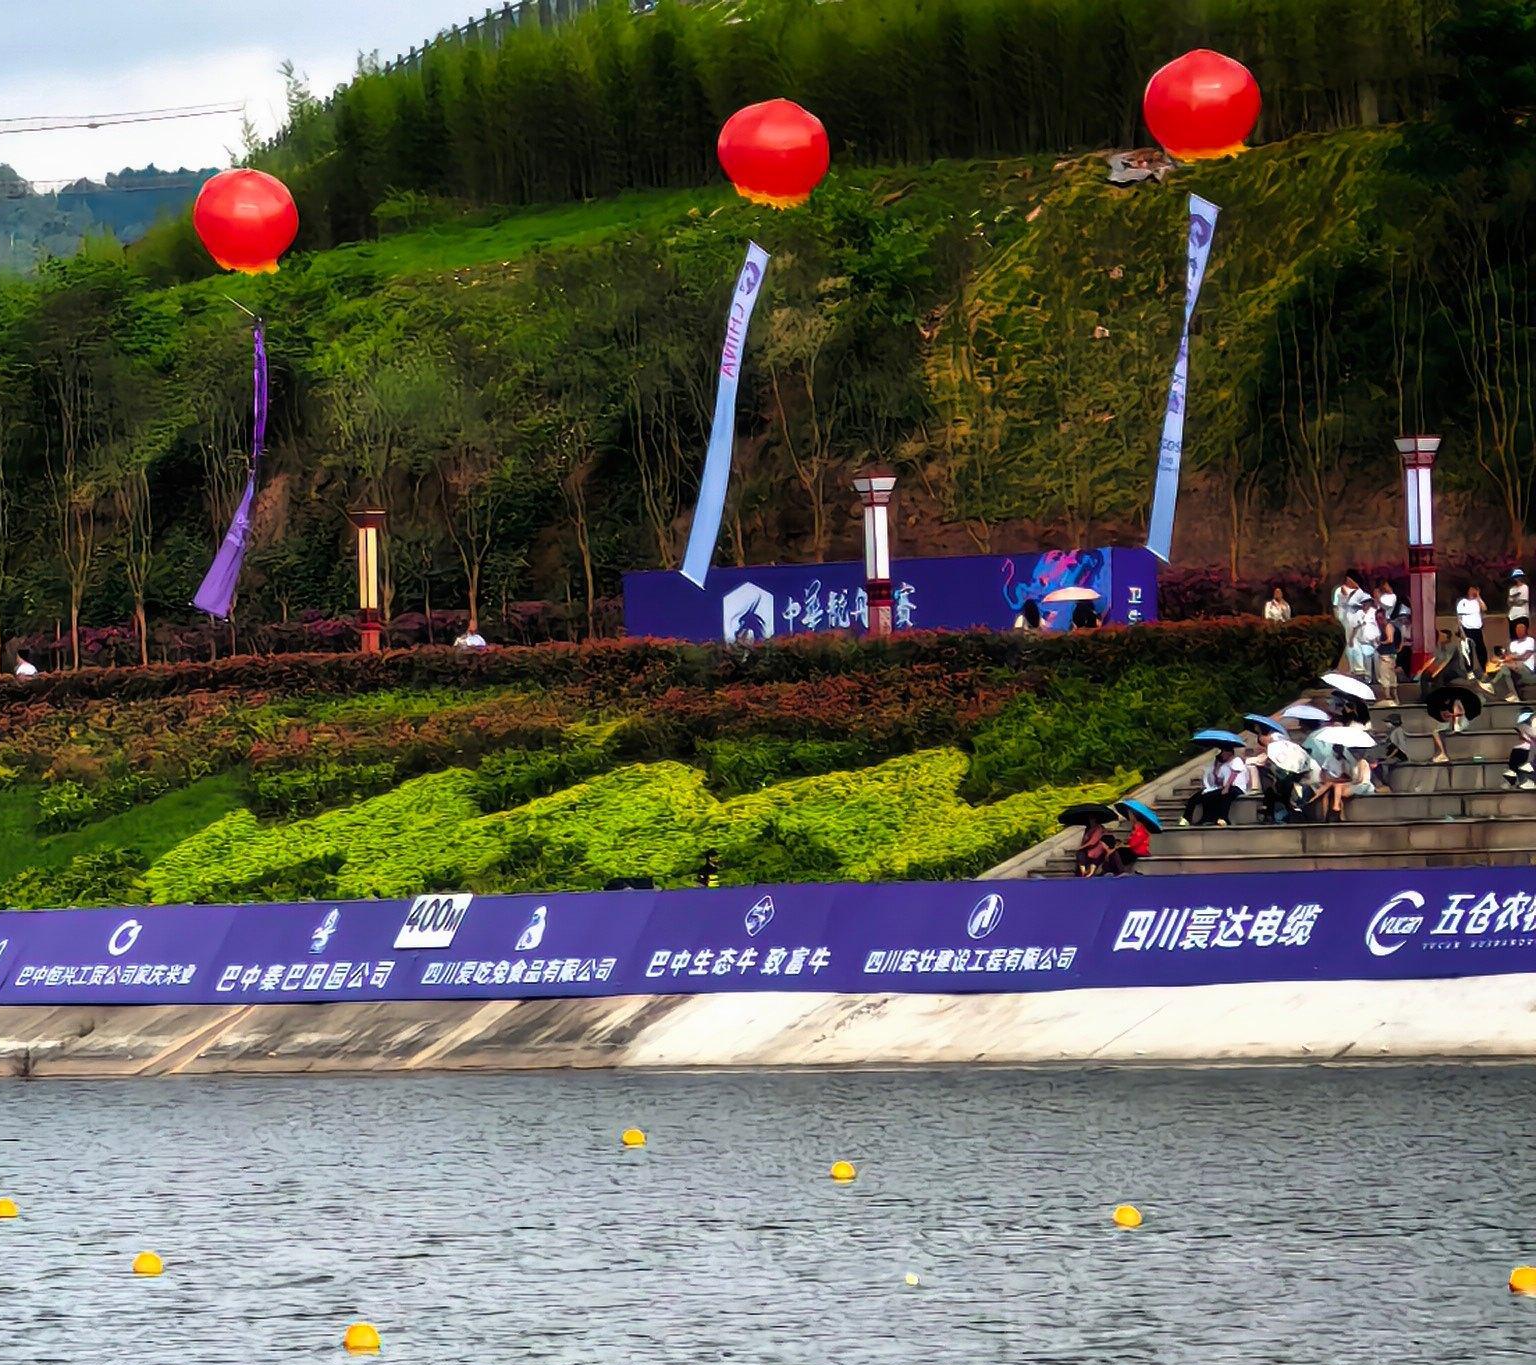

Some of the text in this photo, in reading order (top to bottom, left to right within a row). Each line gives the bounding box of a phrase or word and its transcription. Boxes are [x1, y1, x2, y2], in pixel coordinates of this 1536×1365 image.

[1113, 904, 1323, 952] 四川寰达电缆
